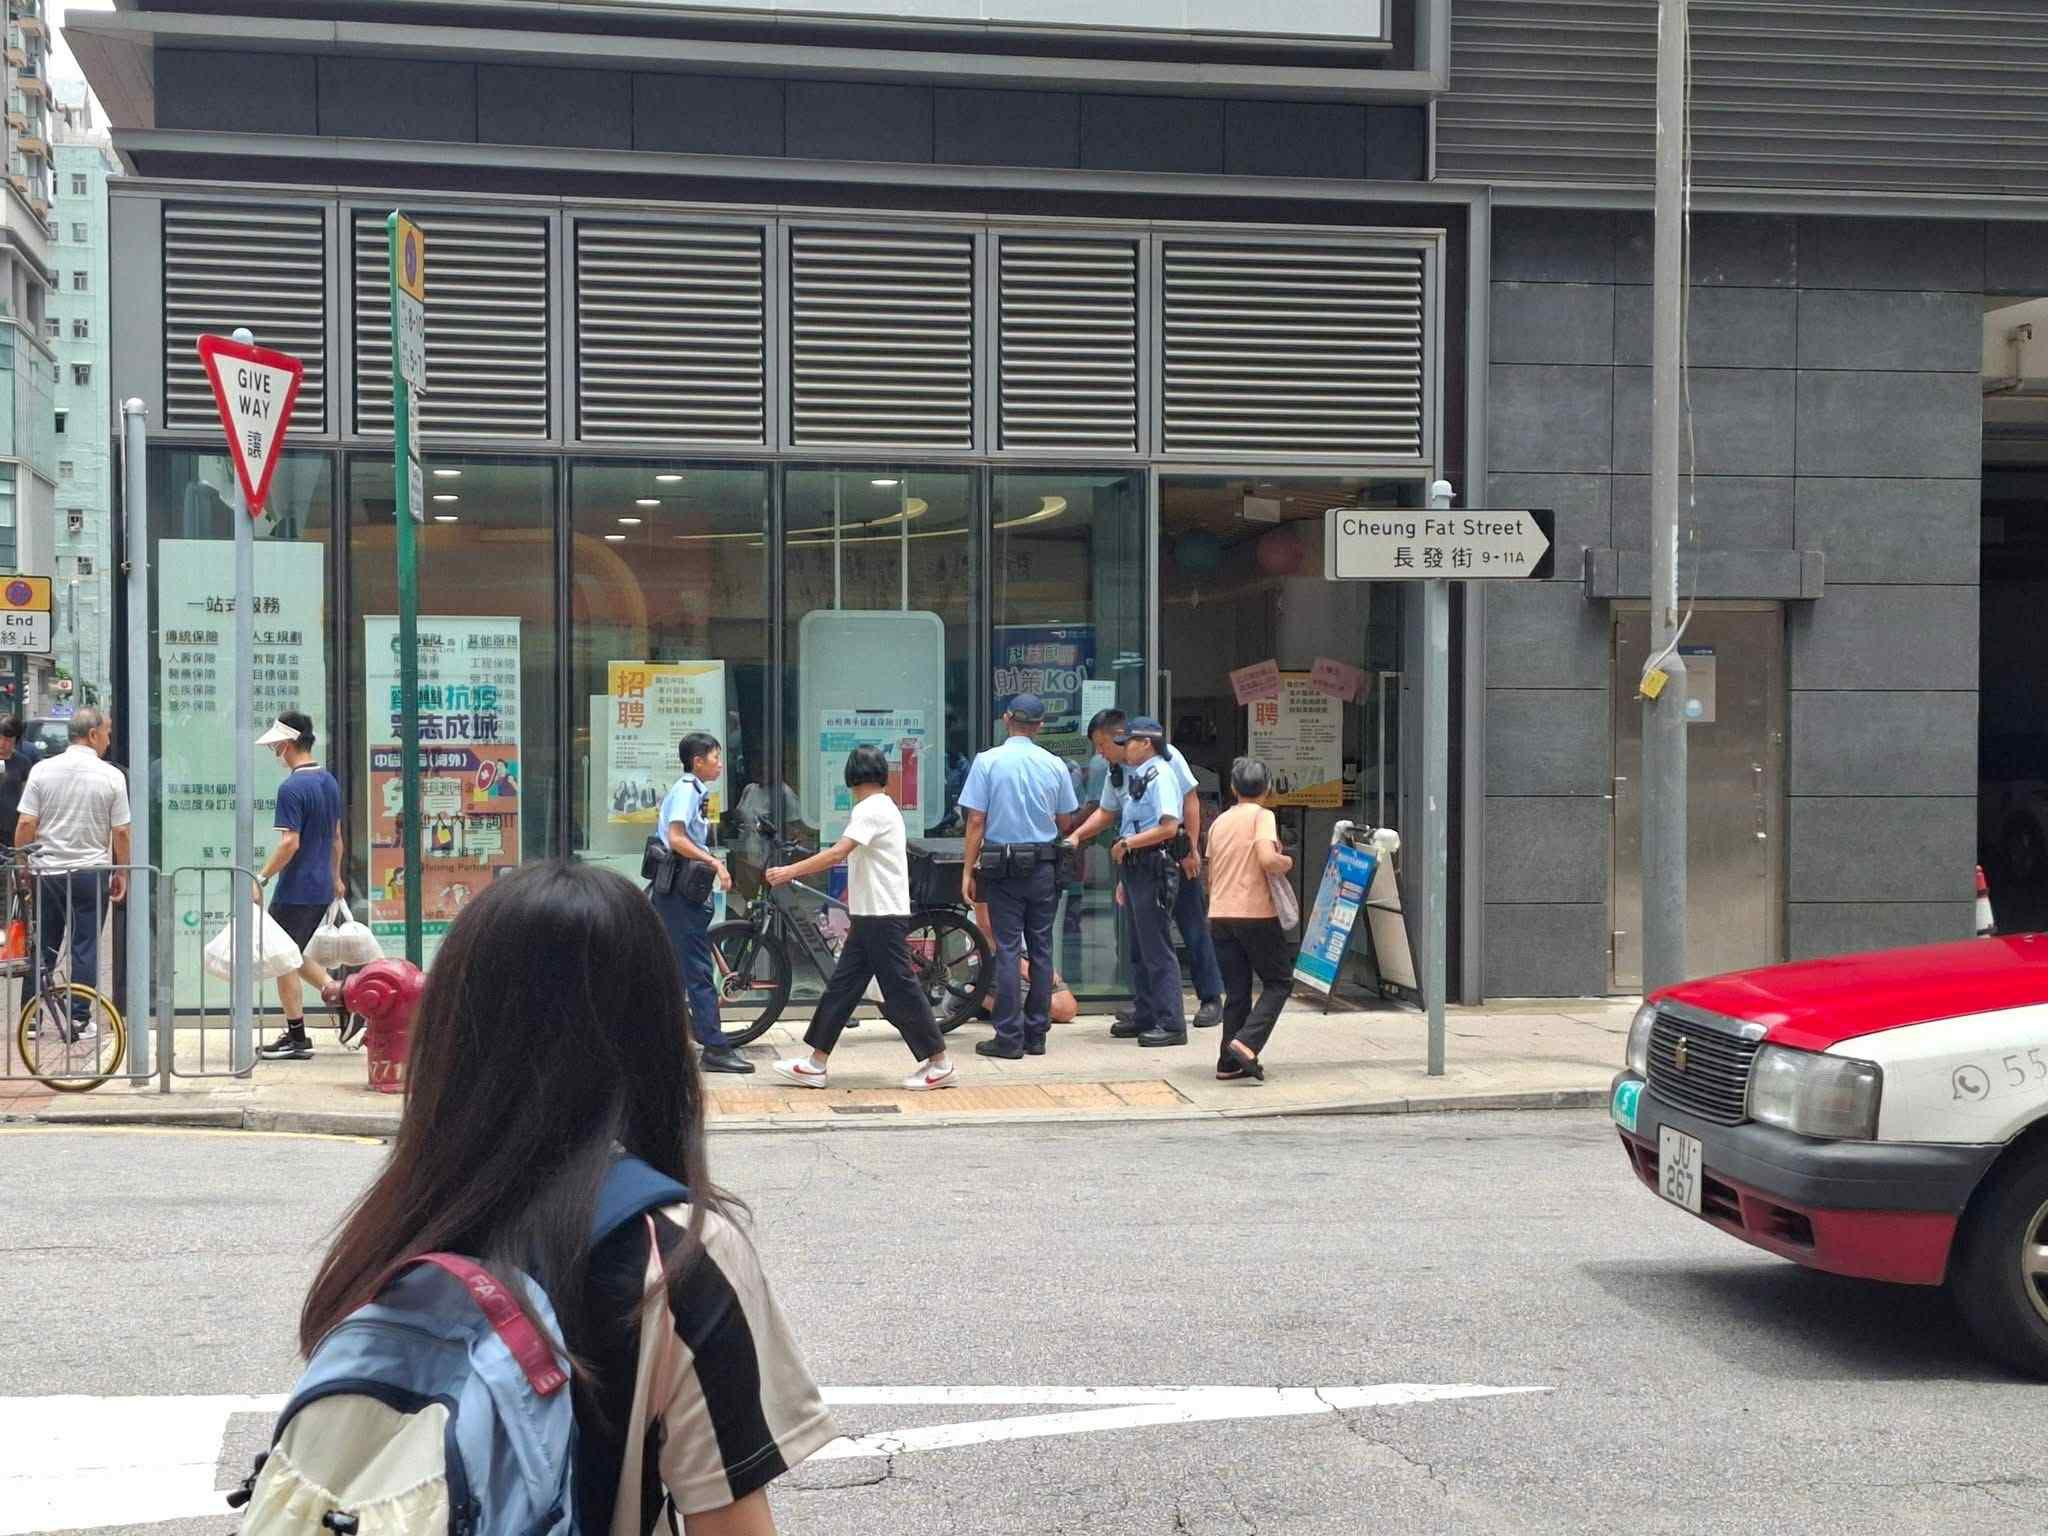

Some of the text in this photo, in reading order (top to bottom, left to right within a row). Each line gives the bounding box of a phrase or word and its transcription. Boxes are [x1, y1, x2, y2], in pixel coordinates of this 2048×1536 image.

[238, 368, 271, 393] GIVE
[239, 395, 270, 420] WAY
[1343, 519, 1524, 539] Cheung Fat Street
[1394, 547, 1472, 569] 長發街
[7, 615, 33, 626] End
[1, 631, 38, 647] 終止
[617, 670, 645, 729] 招聘
[1255, 702, 1279, 726] 聘
[1672, 1136, 1691, 1169] JU
[1667, 1164, 1694, 1205] 267
